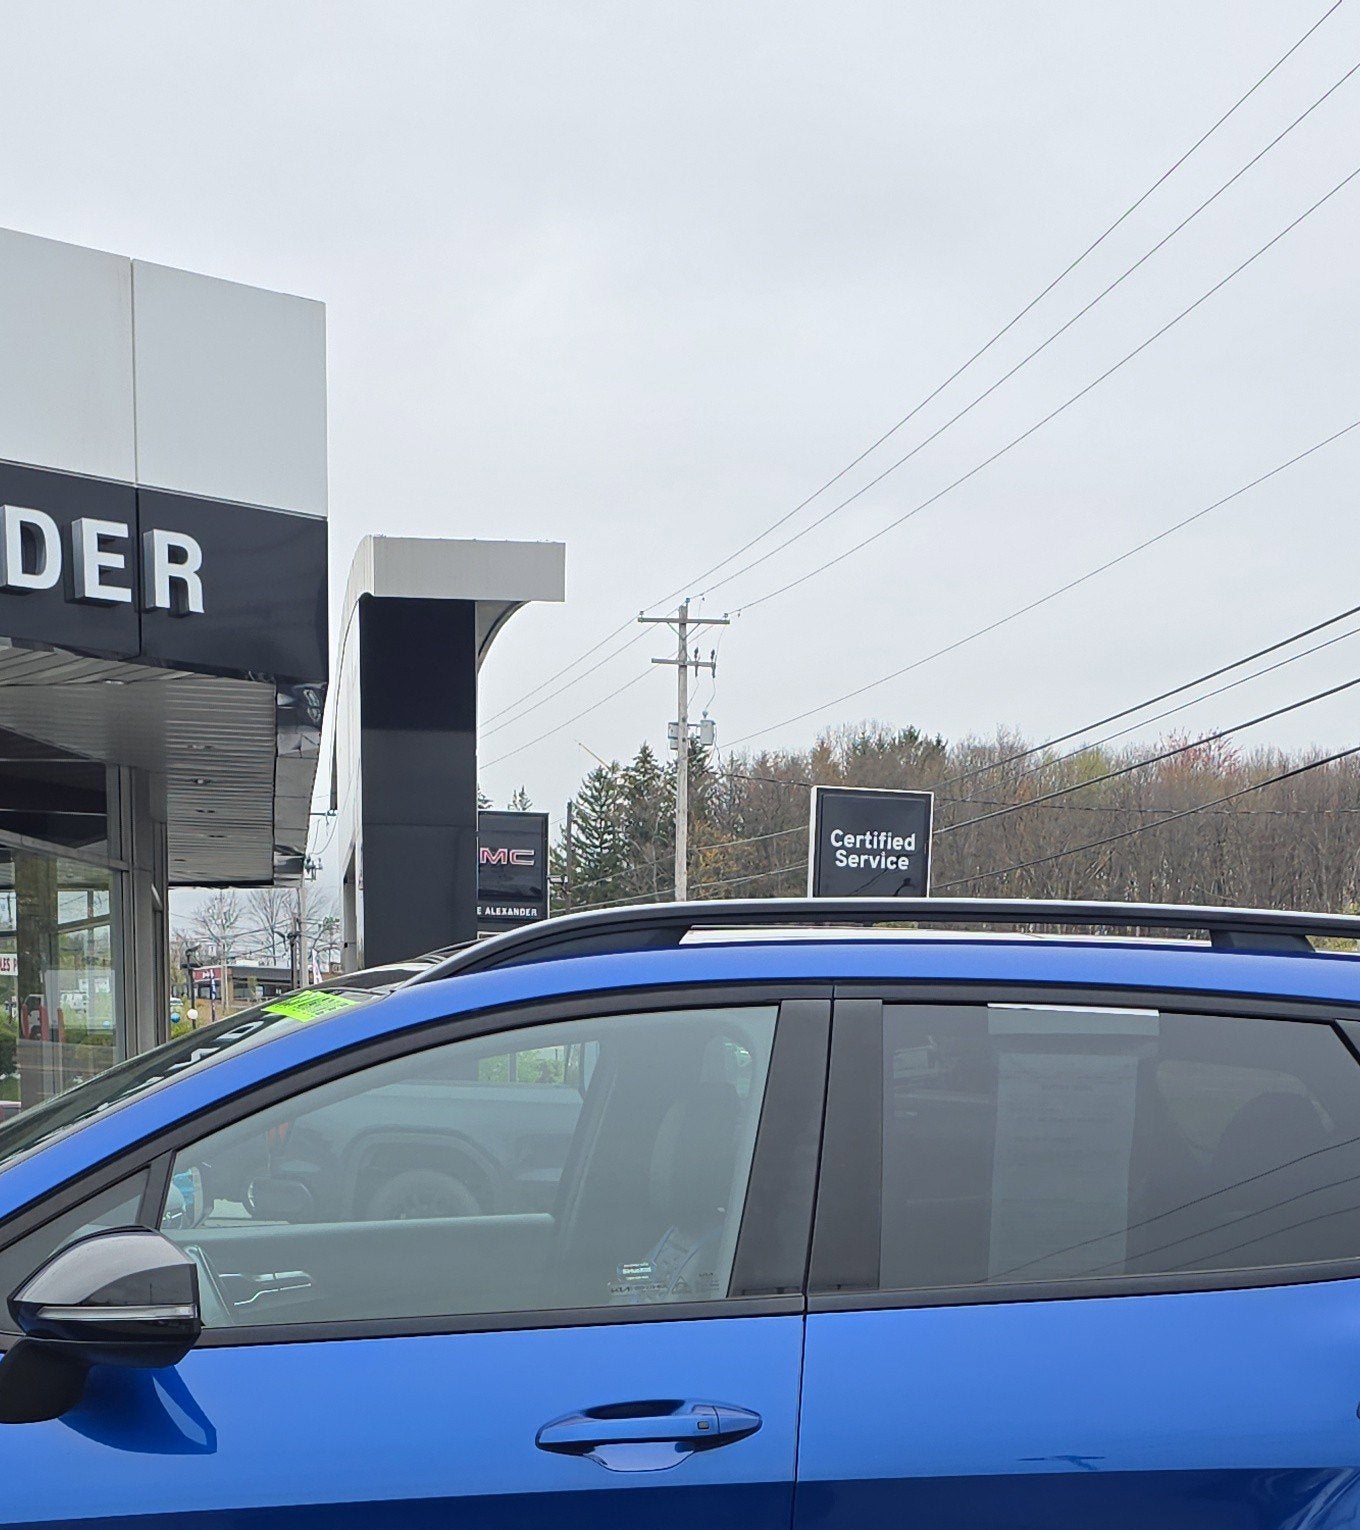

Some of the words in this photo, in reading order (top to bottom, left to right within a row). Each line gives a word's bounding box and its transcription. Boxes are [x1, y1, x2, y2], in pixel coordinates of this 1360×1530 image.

[830, 829, 916, 851] Certified
[480, 847, 534, 866] MC
[835, 849, 910, 870] Service
[485, 906, 538, 917] ALEXANDER
